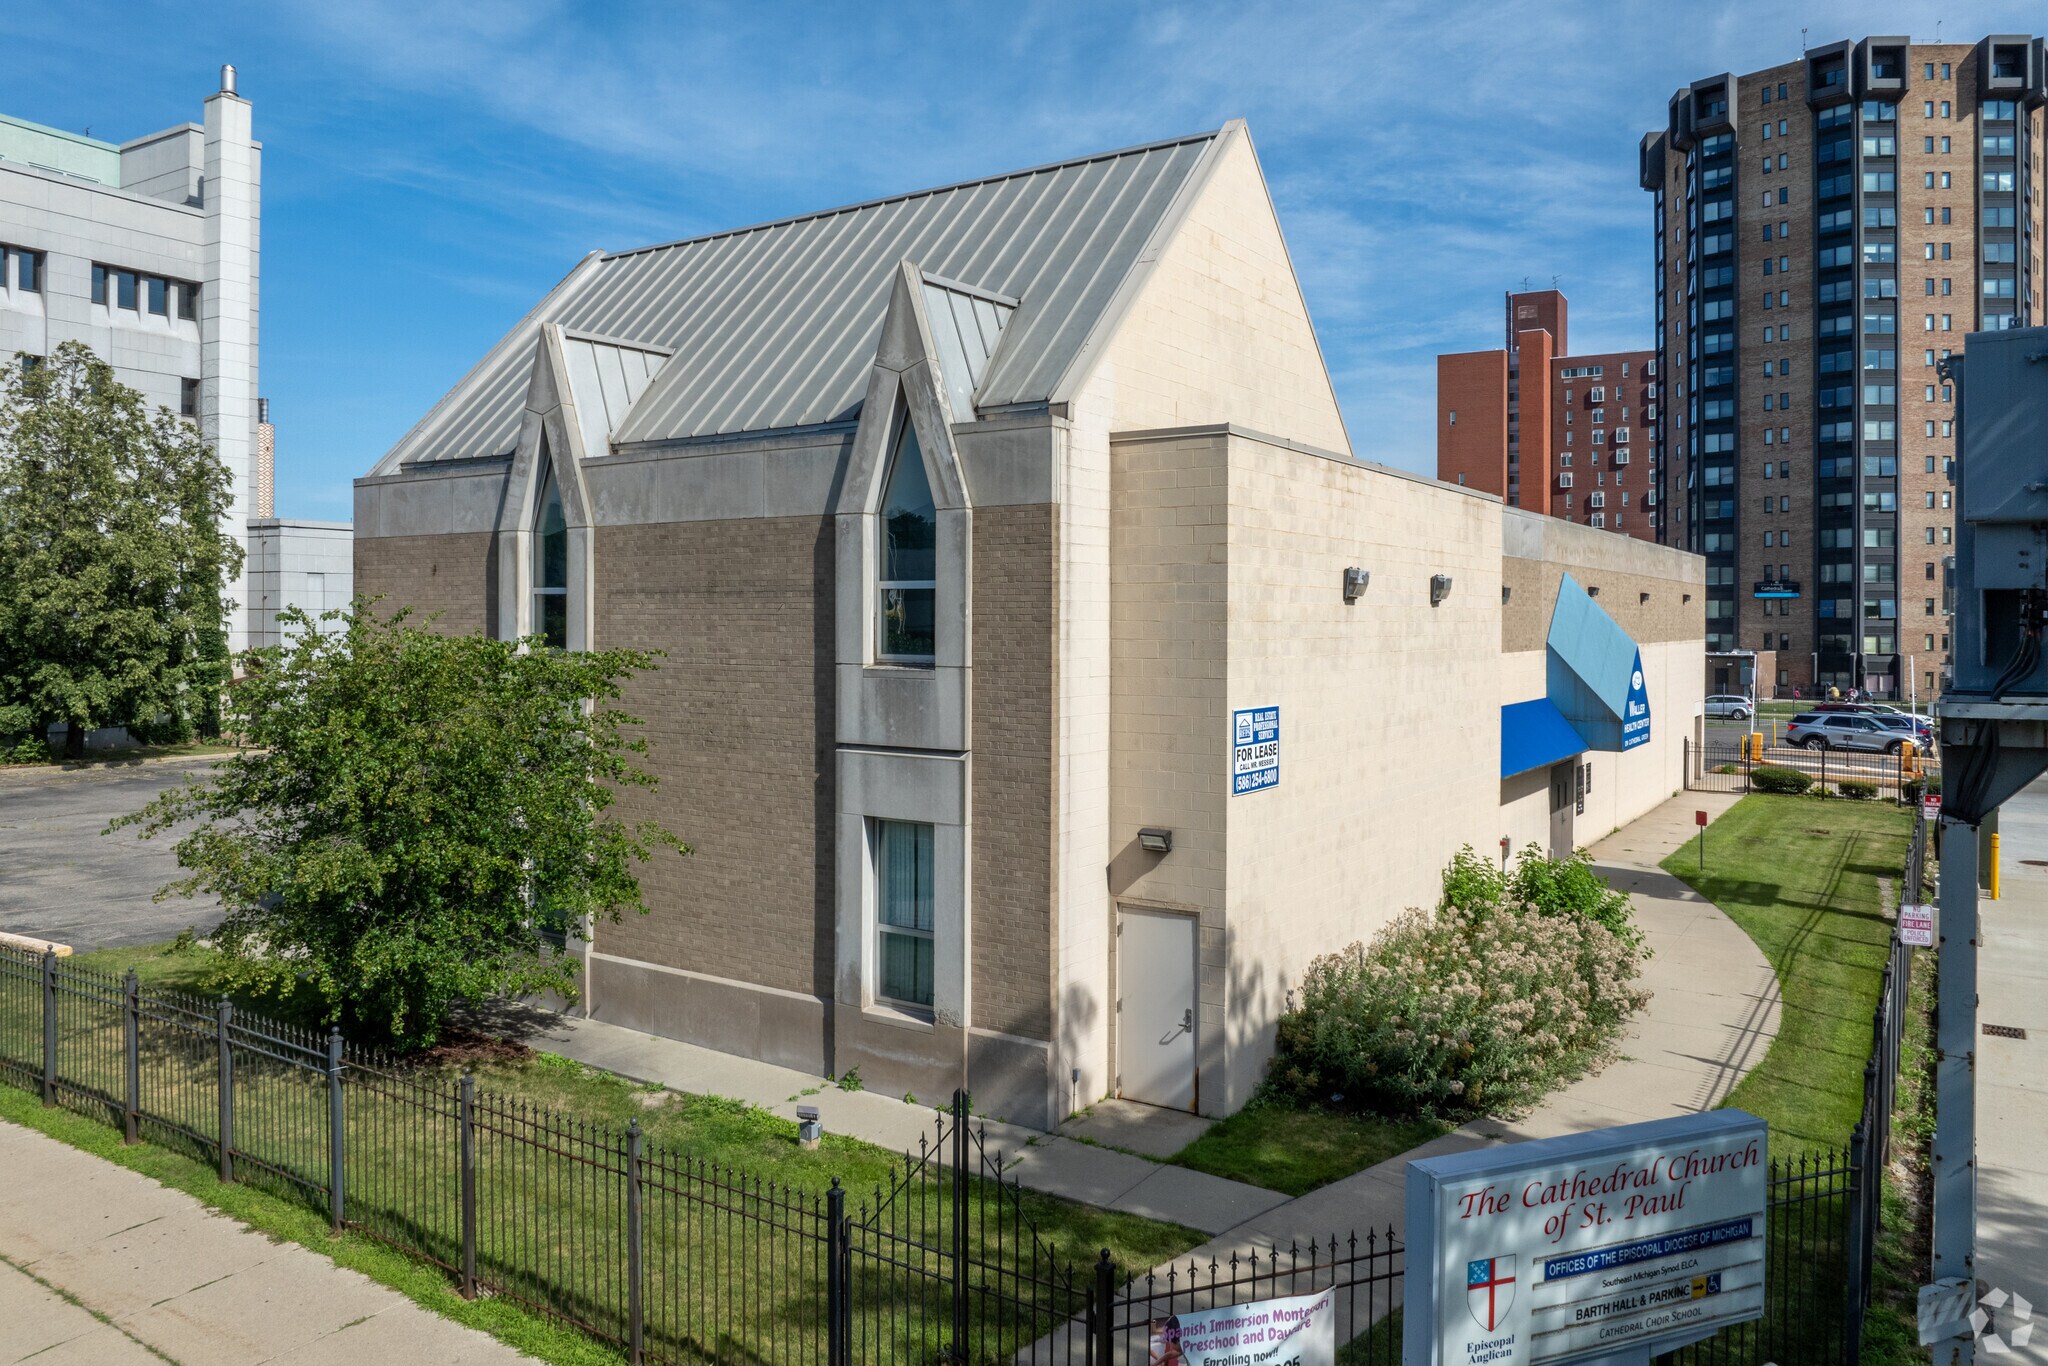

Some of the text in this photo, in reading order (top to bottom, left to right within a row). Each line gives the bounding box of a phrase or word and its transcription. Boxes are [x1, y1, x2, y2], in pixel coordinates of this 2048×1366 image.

[1236, 743, 1276, 762] FOR LEASE
[1240, 762, 1250, 770] CALL
[1236, 774, 1252, 792] (586)
[1903, 920, 1931, 929] FIRE LANE
[1458, 1139, 1760, 1219] The Cathedral Church
[1544, 1180, 1692, 1244] of St. Paul
[1550, 1224, 1750, 1276] OFFICES OF THE EPISCOPAL DIOCESE OF MICHIGAN
[1602, 1274, 1632, 1288] Southeast
[1633, 1268, 1660, 1280] Michigan
[1681, 1259, 1698, 1270] ELCA
[1576, 1302, 1610, 1320] BARTH
[1612, 1297, 1638, 1312] HALL
[1640, 1294, 1647, 1306] &
[1210, 1313, 1268, 1333] Immersion
[1600, 1306, 1702, 1339] CATHEDRAL CHOIR SCHOOL
[1182, 1333, 1240, 1353] Preschool
[1243, 1328, 1264, 1344] and
[1467, 1334, 1514, 1354] Episcopal
[1204, 1352, 1250, 1366] Enrolling
[1468, 1348, 1512, 1364] Anglican
